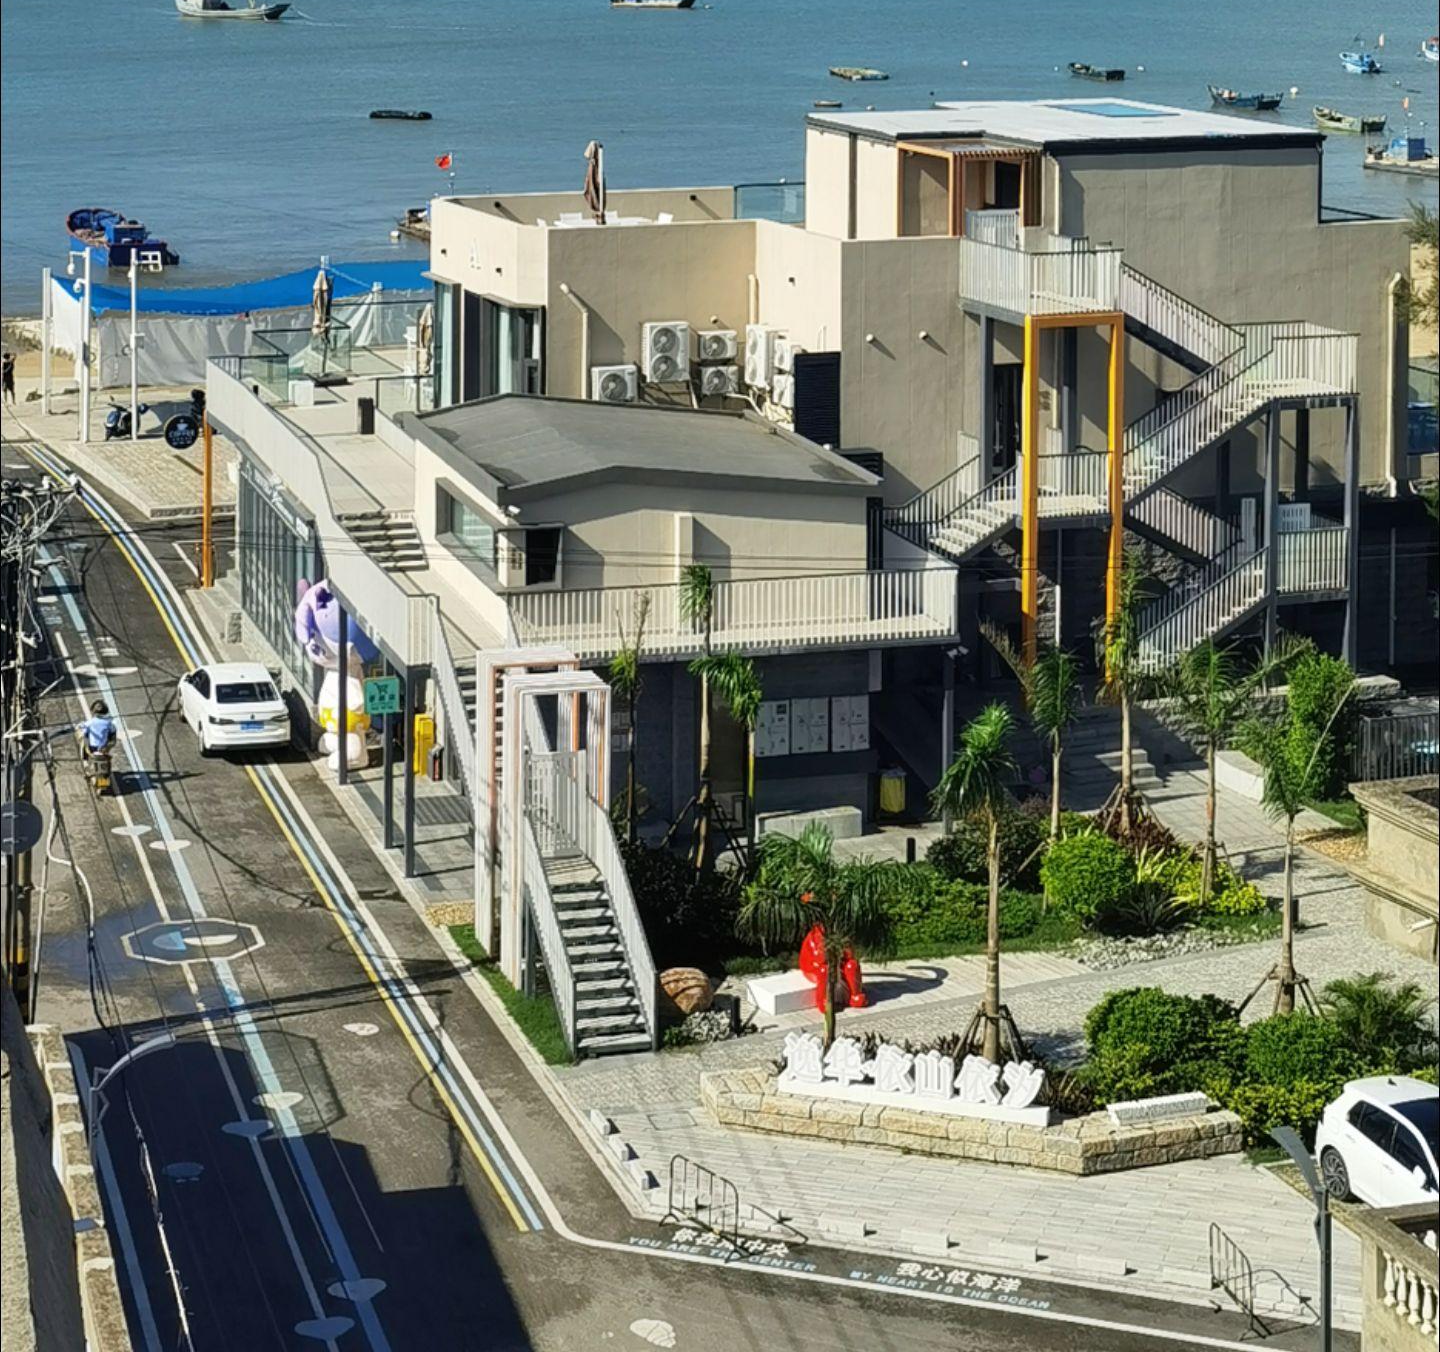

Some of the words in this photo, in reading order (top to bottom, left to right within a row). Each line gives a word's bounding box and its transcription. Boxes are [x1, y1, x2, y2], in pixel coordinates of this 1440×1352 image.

[628, 1236, 661, 1248] YOU
[667, 1243, 701, 1254] ARE
[749, 1255, 817, 1272] CENTER
[850, 1270, 872, 1280] MY
[876, 1275, 929, 1290] HEART
[935, 1284, 954, 1294] IS
[961, 1289, 995, 1301] THE
[997, 1295, 1051, 1309] OCEAN
